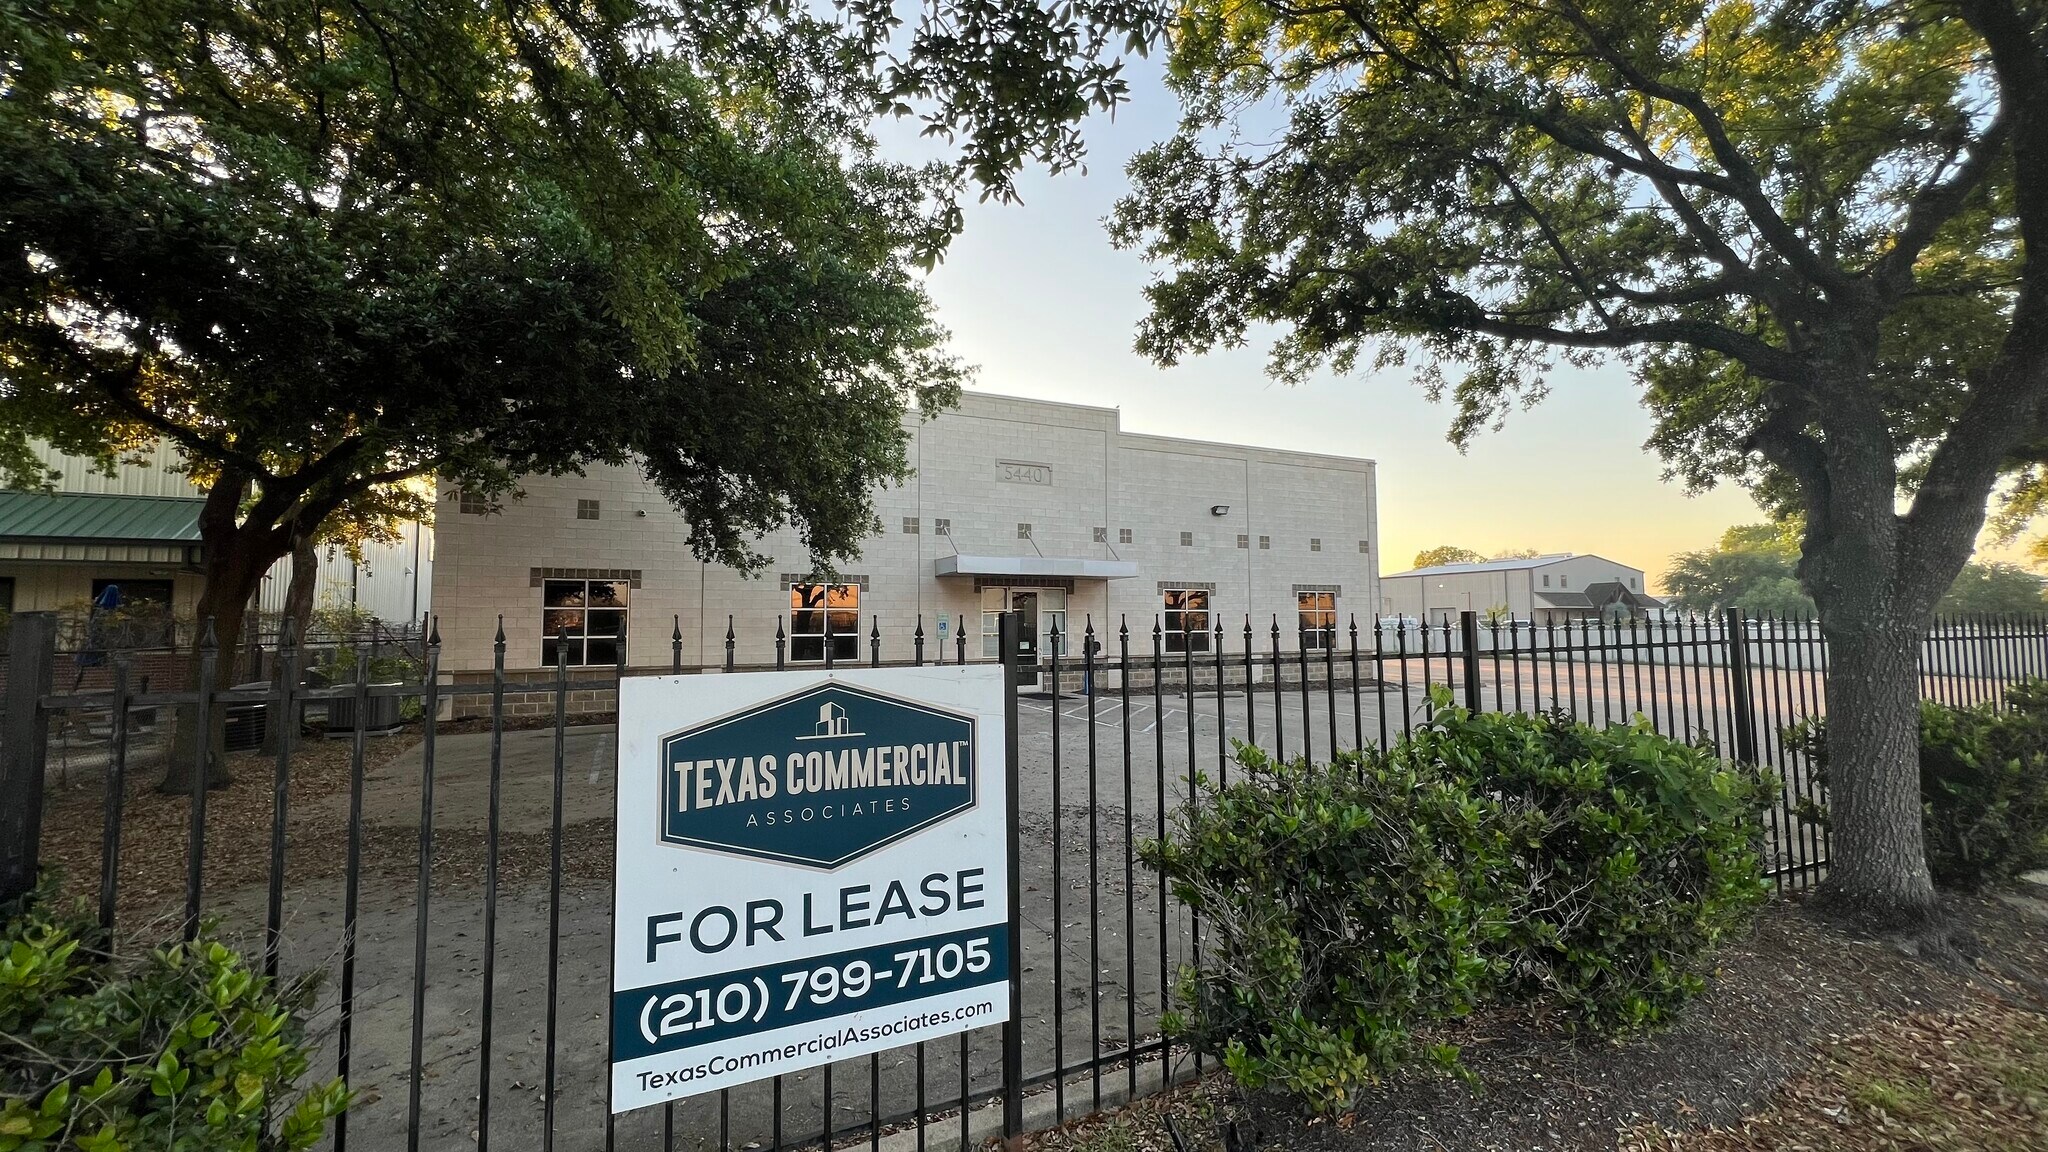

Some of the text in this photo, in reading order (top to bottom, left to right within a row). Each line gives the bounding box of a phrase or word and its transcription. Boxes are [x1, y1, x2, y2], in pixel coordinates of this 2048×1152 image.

[1004, 466, 1042, 483] 5440
[673, 753, 778, 813] TEXAS
[745, 797, 911, 828] ASSOCIATES
[646, 867, 985, 964] FOR LEASE
[639, 936, 992, 1045] (210) 799-7105
[636, 999, 994, 1091] TexasCommercialAssociates.com
